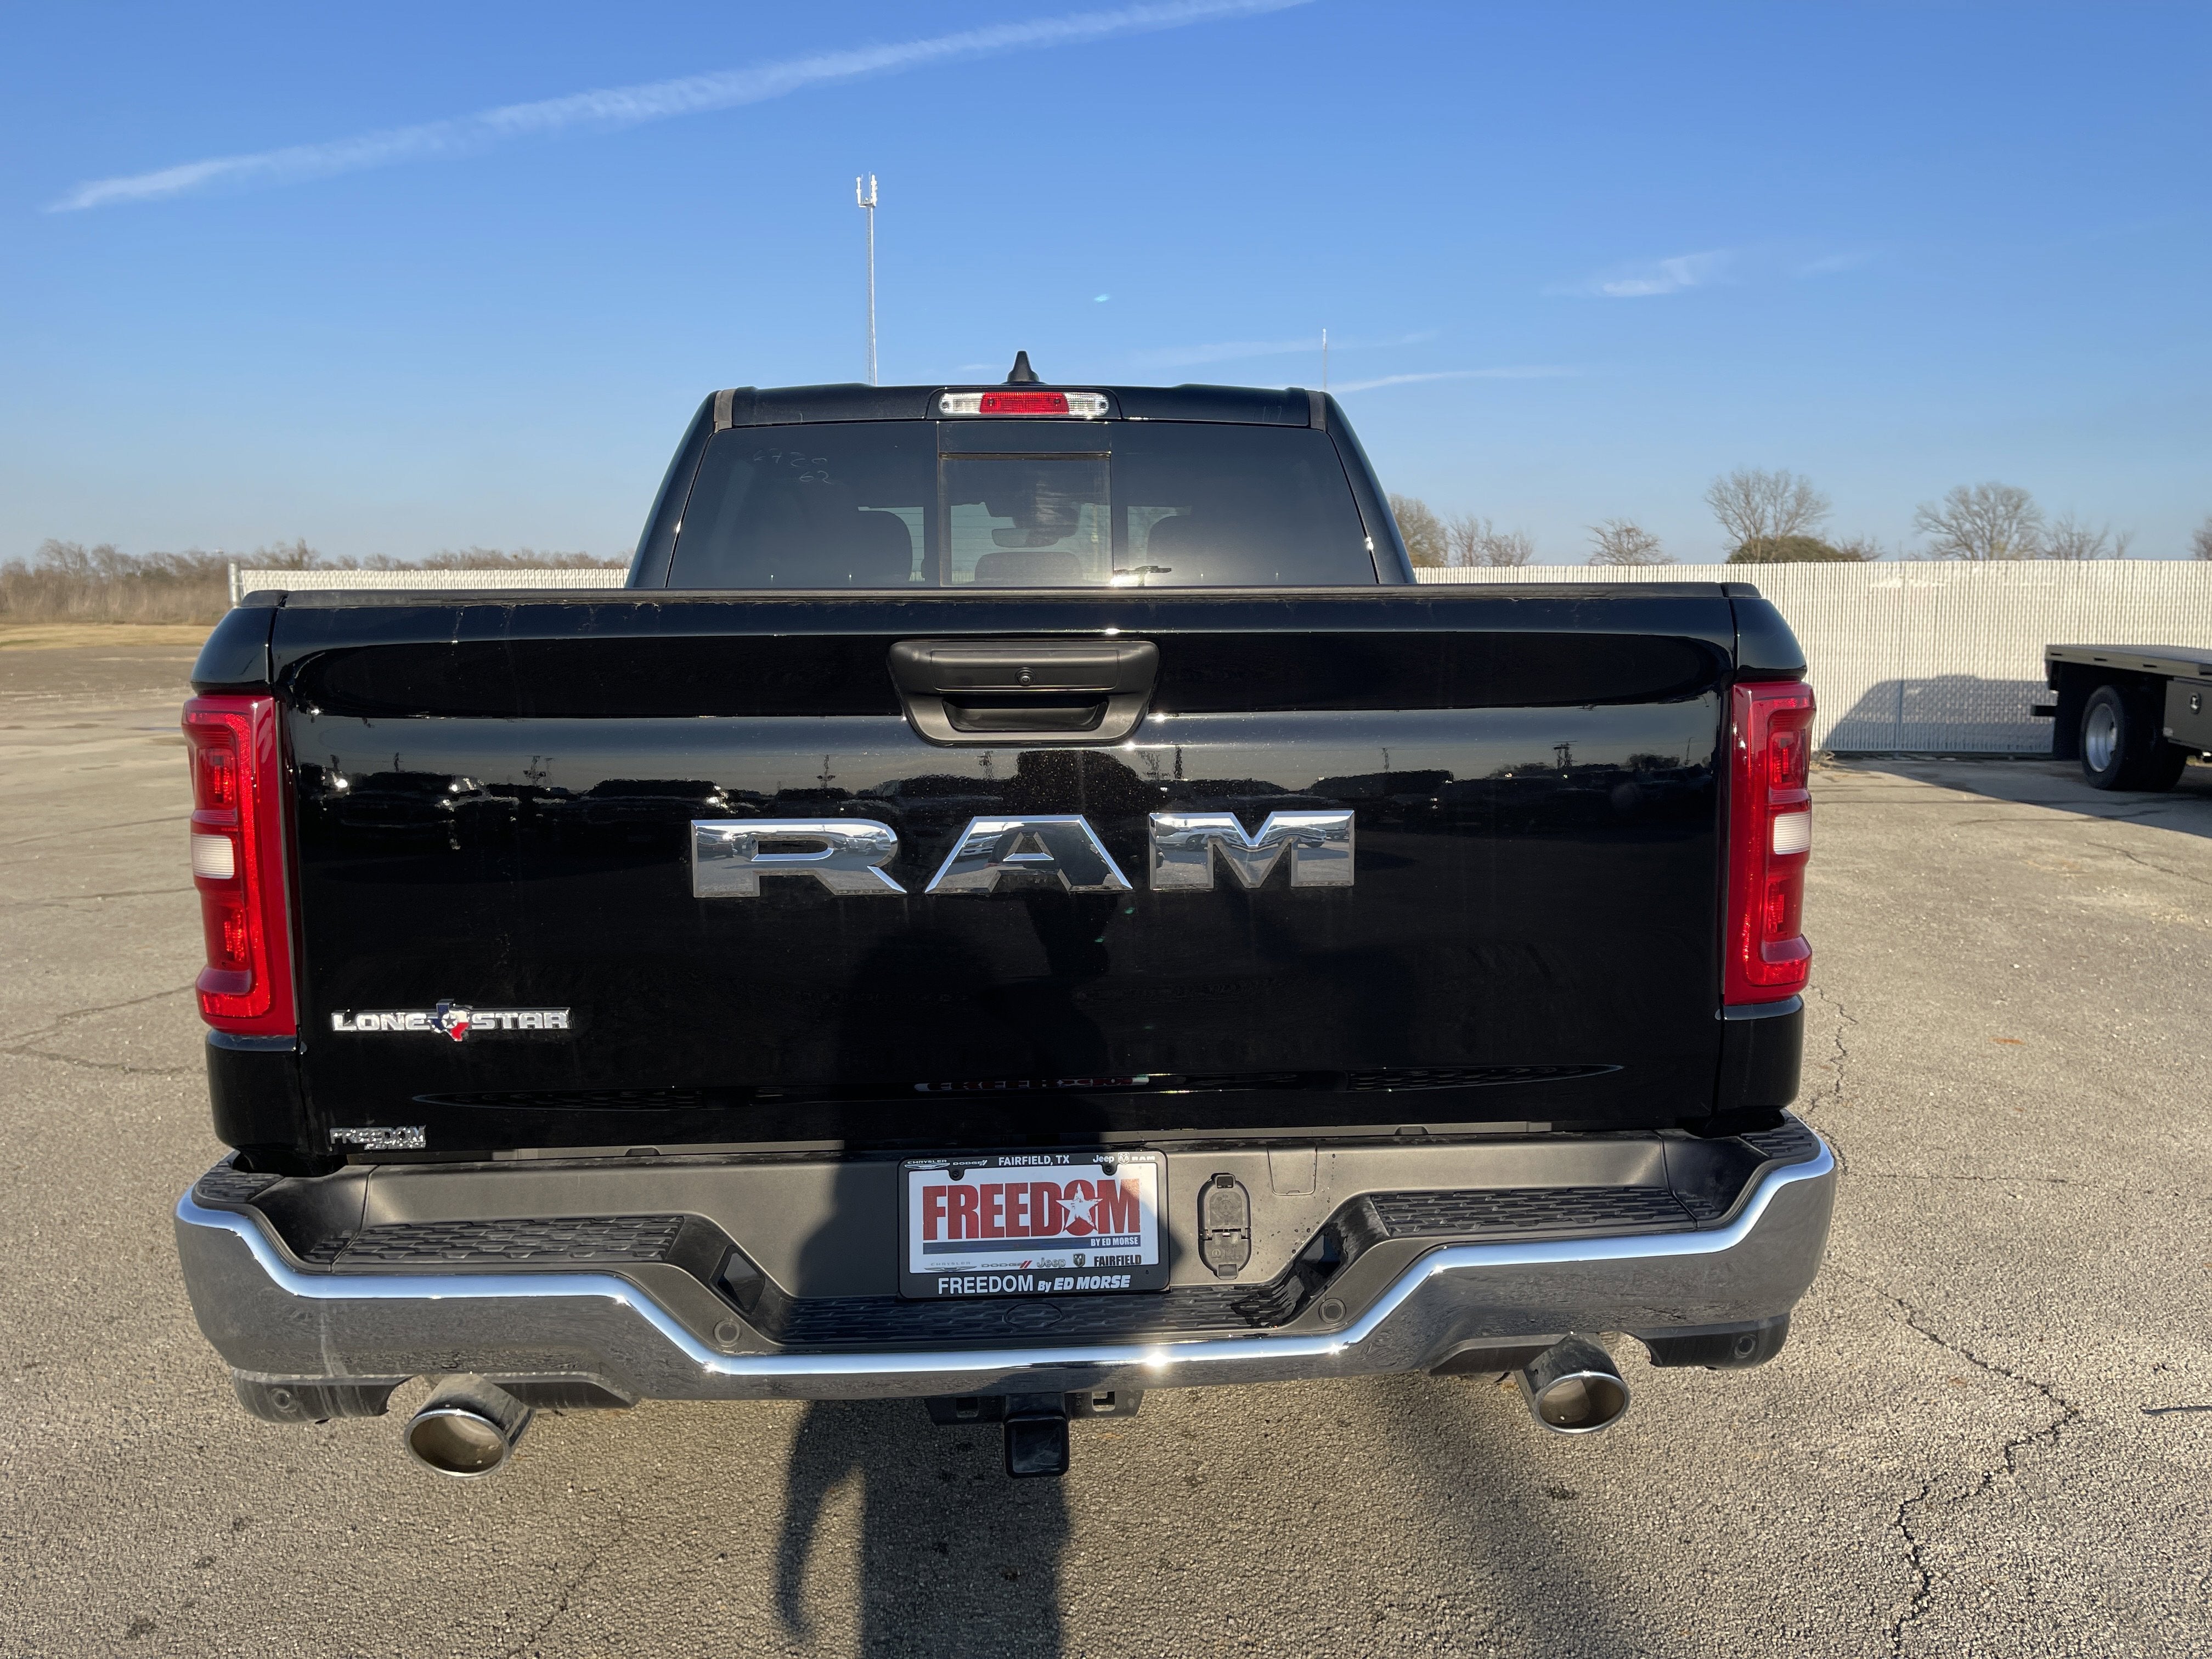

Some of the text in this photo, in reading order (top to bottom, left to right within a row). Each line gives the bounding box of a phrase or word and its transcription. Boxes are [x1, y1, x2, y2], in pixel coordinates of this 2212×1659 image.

[690, 809, 1355, 898] RAM
[331, 1008, 572, 1032] LONE STAR
[998, 1154, 1070, 1166] FAIRFIELD, TX
[1092, 1154, 1115, 1164] Jeep
[922, 1179, 1141, 1240] FREEDOM
[1091, 1237, 1138, 1246] BY ED MORSE
[1036, 1257, 1066, 1268] Jeep
[1093, 1254, 1142, 1267] FAIRFIELD
[938, 1274, 1131, 1295] FREEDOM By ED MORSE
